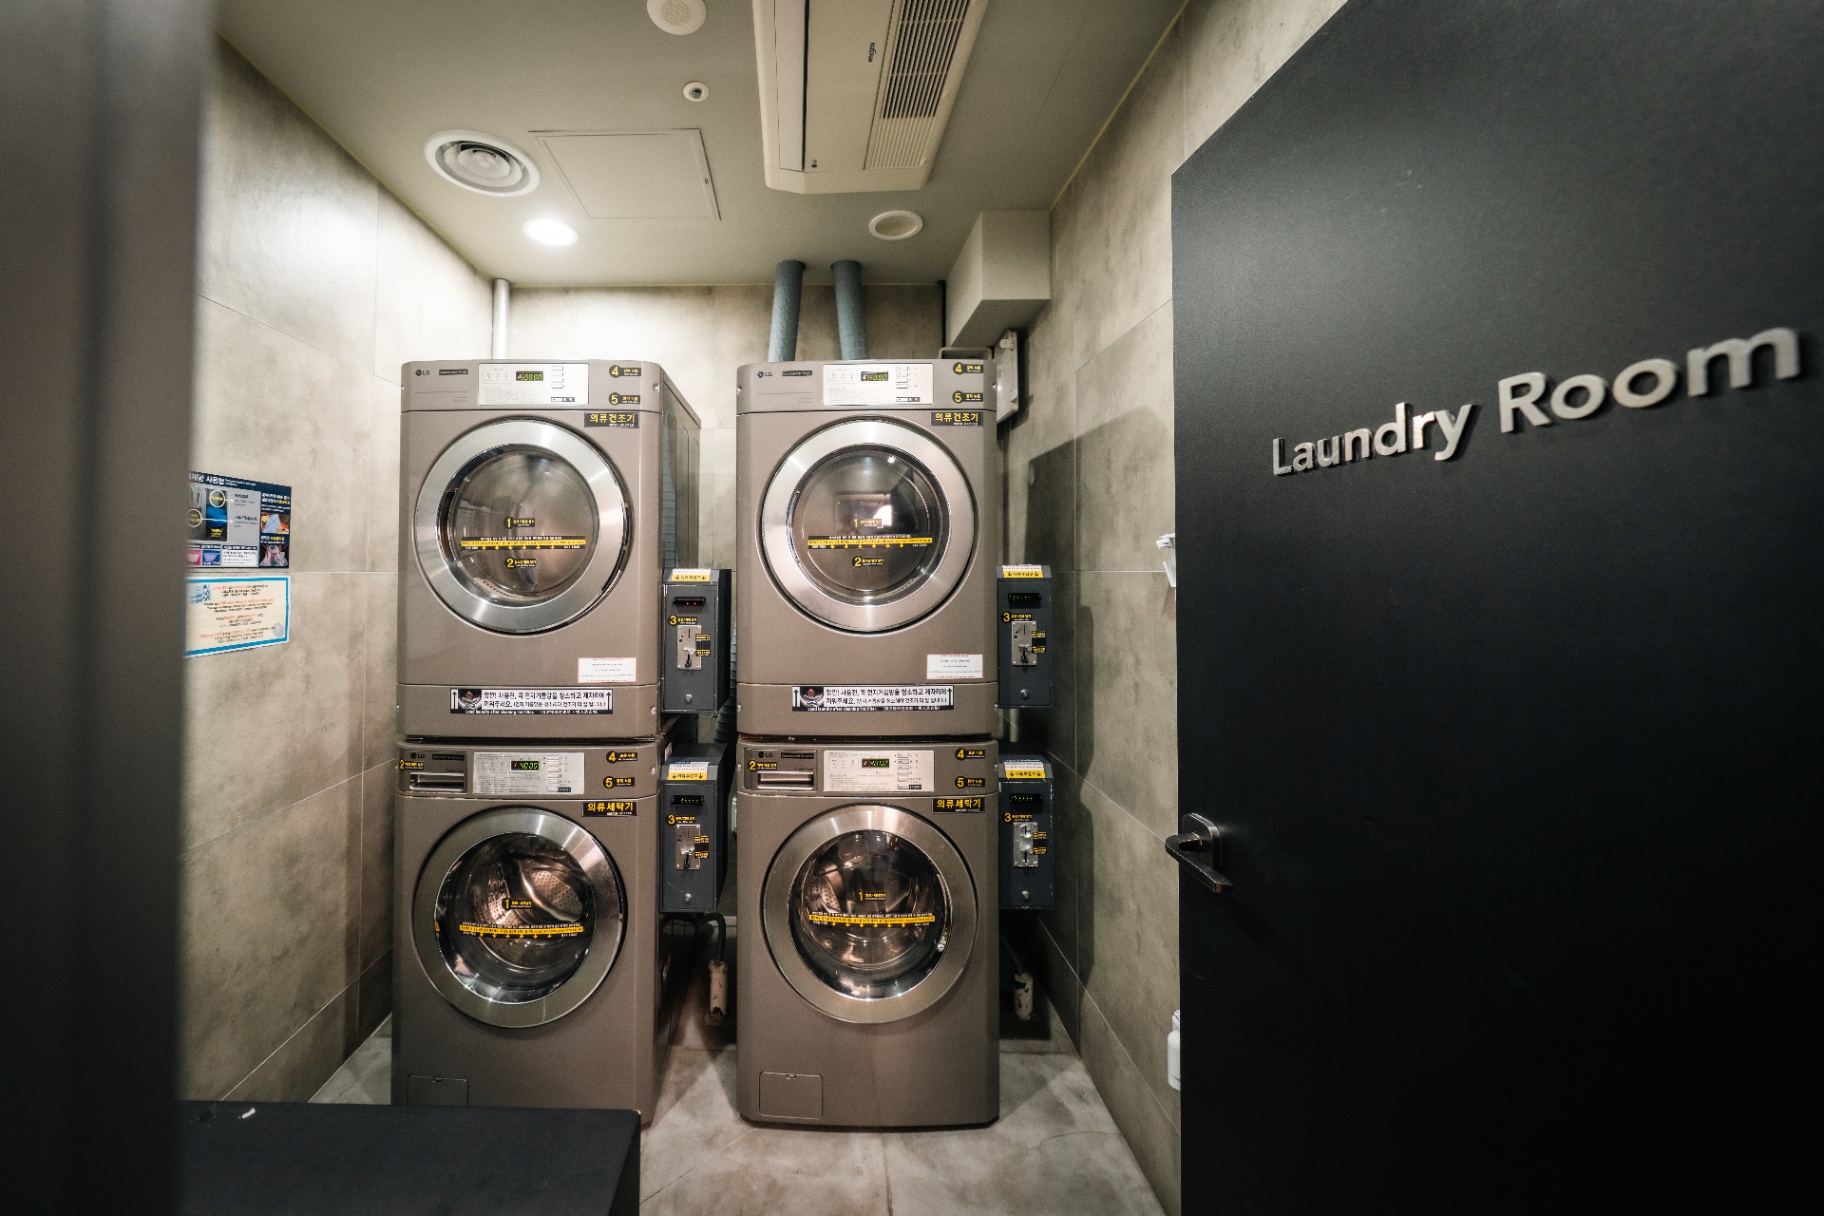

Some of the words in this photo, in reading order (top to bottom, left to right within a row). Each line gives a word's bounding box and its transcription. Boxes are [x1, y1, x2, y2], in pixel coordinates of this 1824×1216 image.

[611, 366, 619, 377] 4
[955, 364, 962, 373] 4
[611, 394, 618, 405] 5
[954, 392, 962, 403] 5
[1272, 402, 1475, 475] Laundry
[1498, 327, 1800, 434] Room
[590, 413, 634, 424] 의류건조기
[935, 412, 978, 423] 의류건조기
[506, 558, 514, 568] 2
[854, 557, 862, 567] 2
[669, 615, 677, 625] 3
[1002, 612, 1010, 622] 3
[609, 752, 616, 762] 4
[957, 749, 965, 758] 4
[399, 759, 405, 769] 2
[749, 760, 756, 771] 2
[605, 778, 613, 788] 5
[957, 778, 964, 788] 5
[587, 802, 633, 812] 의류세탁기
[937, 799, 981, 809] 의류세탁기
[667, 814, 675, 825] 3
[1004, 812, 1012, 822] 3
